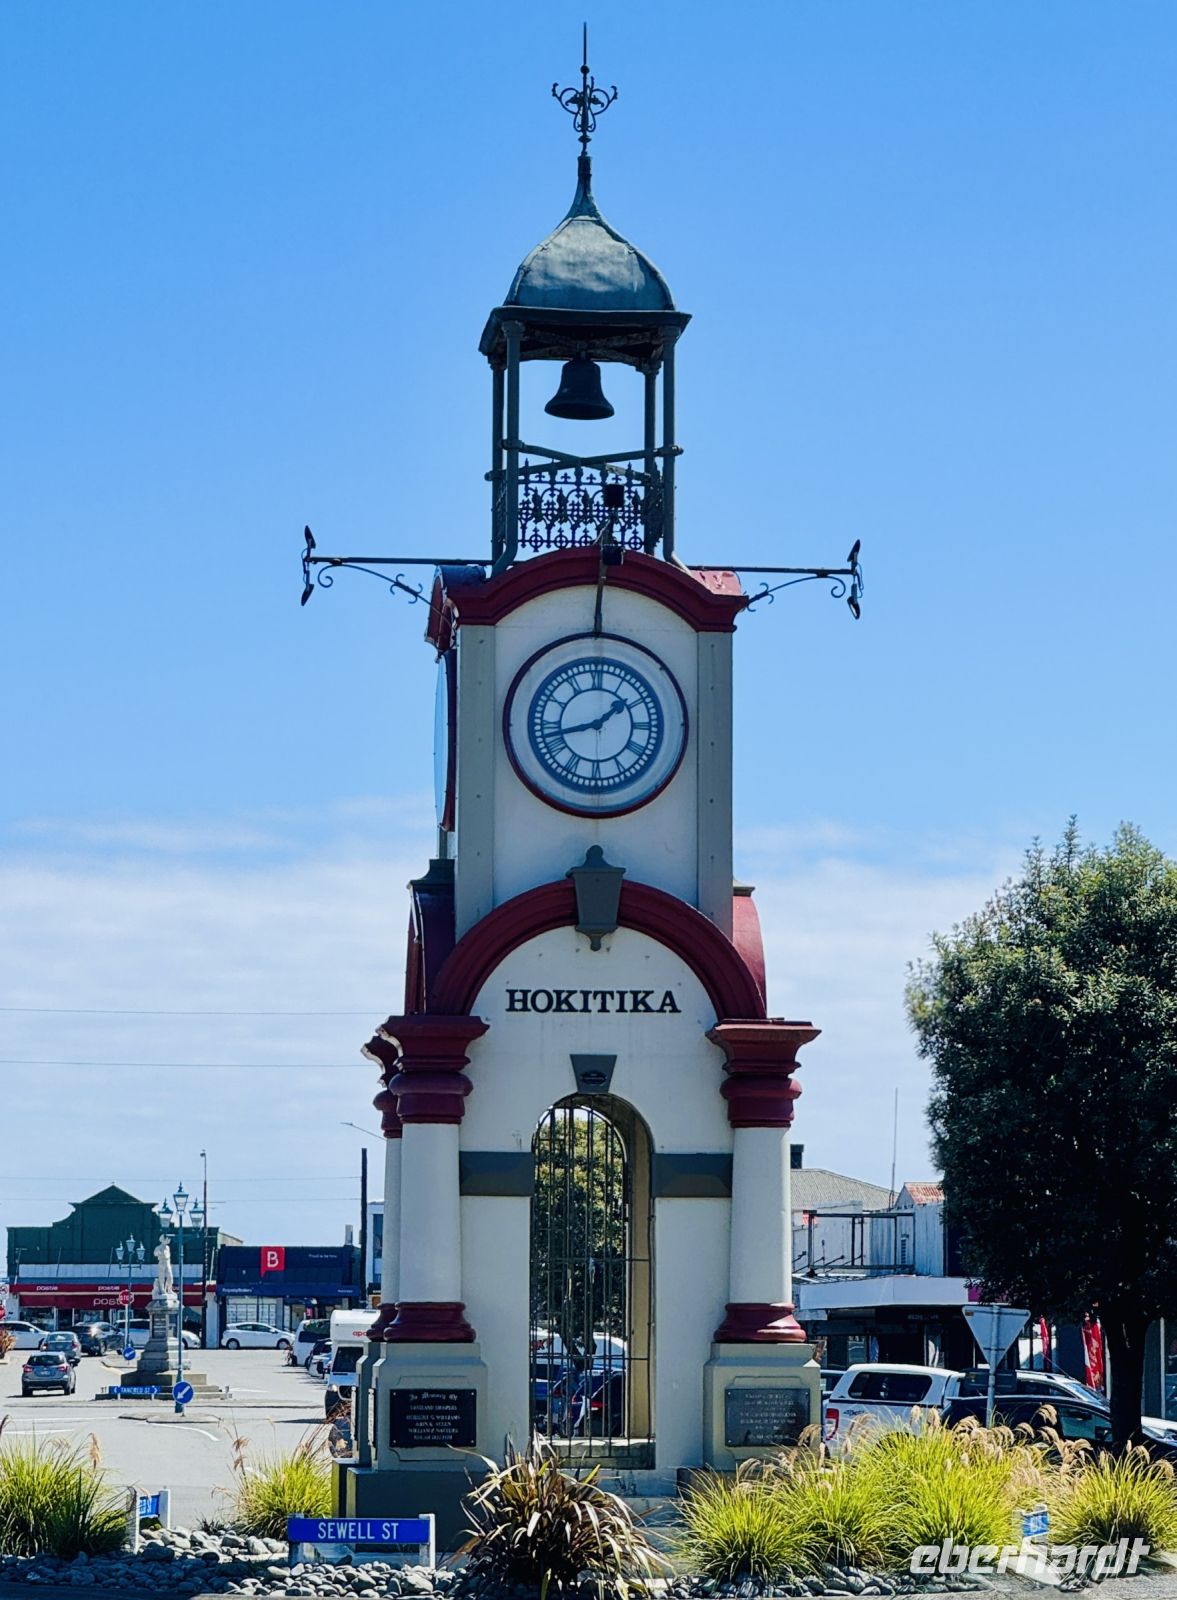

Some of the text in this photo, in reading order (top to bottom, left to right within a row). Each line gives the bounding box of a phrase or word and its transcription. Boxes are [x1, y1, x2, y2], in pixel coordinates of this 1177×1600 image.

[567, 676, 582, 694] XI
[590, 671, 603, 689] XII
[550, 695, 566, 709] X
[627, 697, 645, 709] II
[632, 722, 650, 731] III
[505, 989, 682, 1013] HOKITIKA
[267, 1251, 279, 1267] B
[93, 1298, 121, 1306] post
[317, 1522, 419, 1540] SEWELL ST
